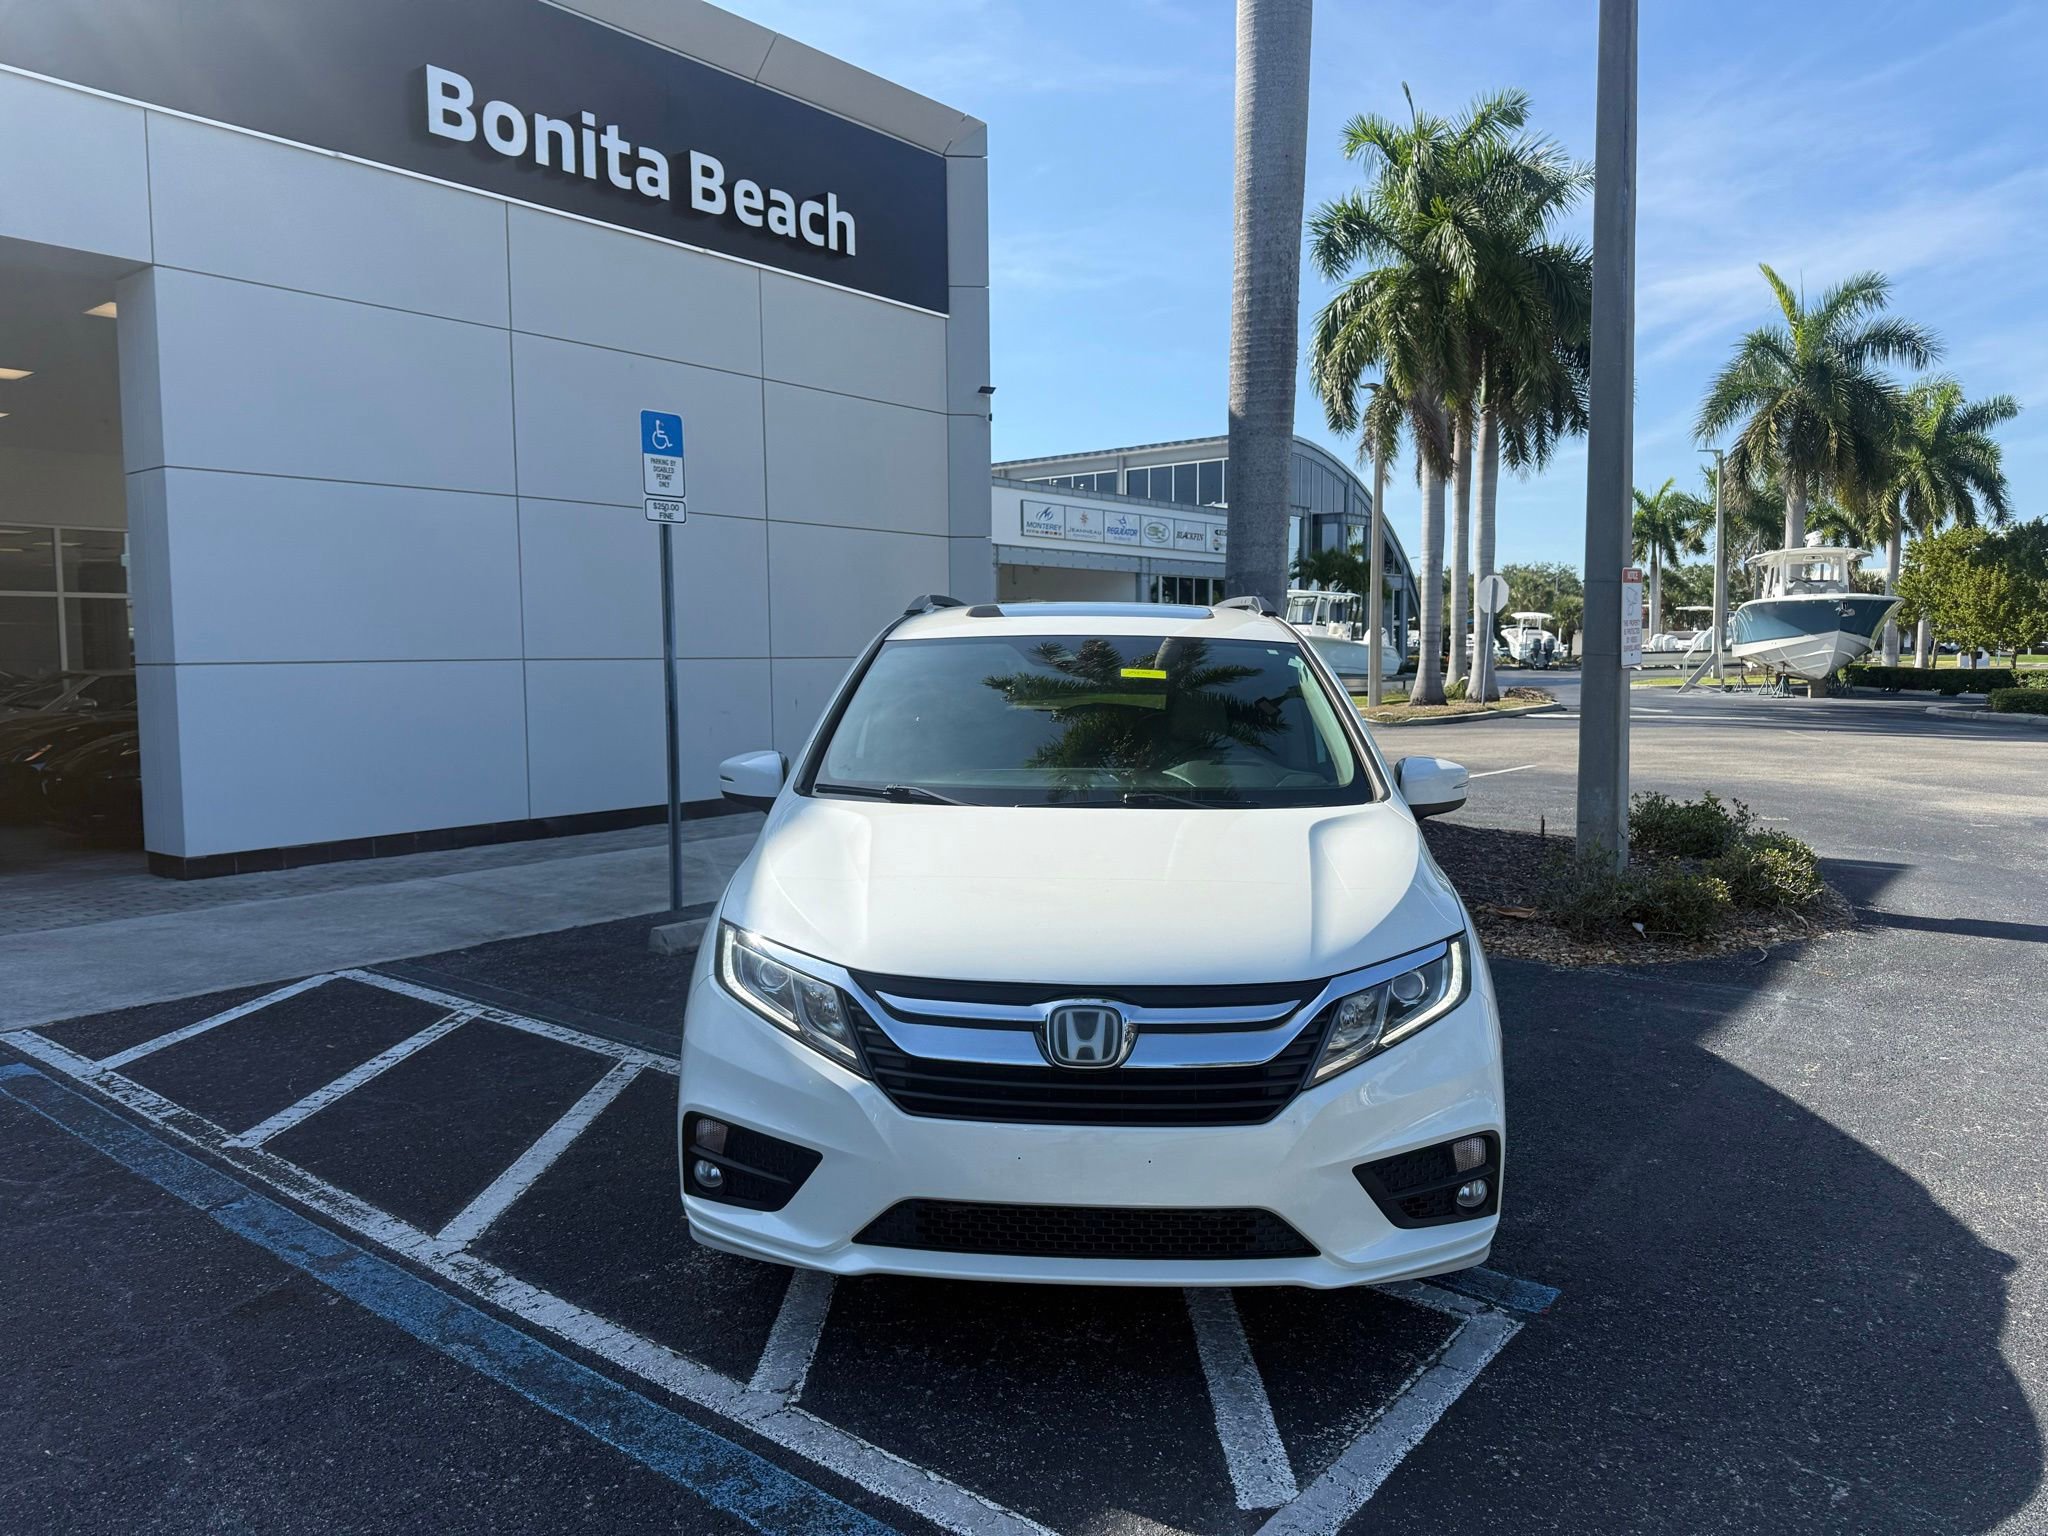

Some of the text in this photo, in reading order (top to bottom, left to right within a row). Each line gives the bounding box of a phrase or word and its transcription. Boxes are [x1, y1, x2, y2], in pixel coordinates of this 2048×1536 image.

[426, 64, 856, 256] Bonita Beach
[650, 458, 669, 466] PARKING
[653, 502, 679, 512] $250.00
[659, 512, 674, 520] FINE
[1026, 521, 1062, 531] MONTEREY
